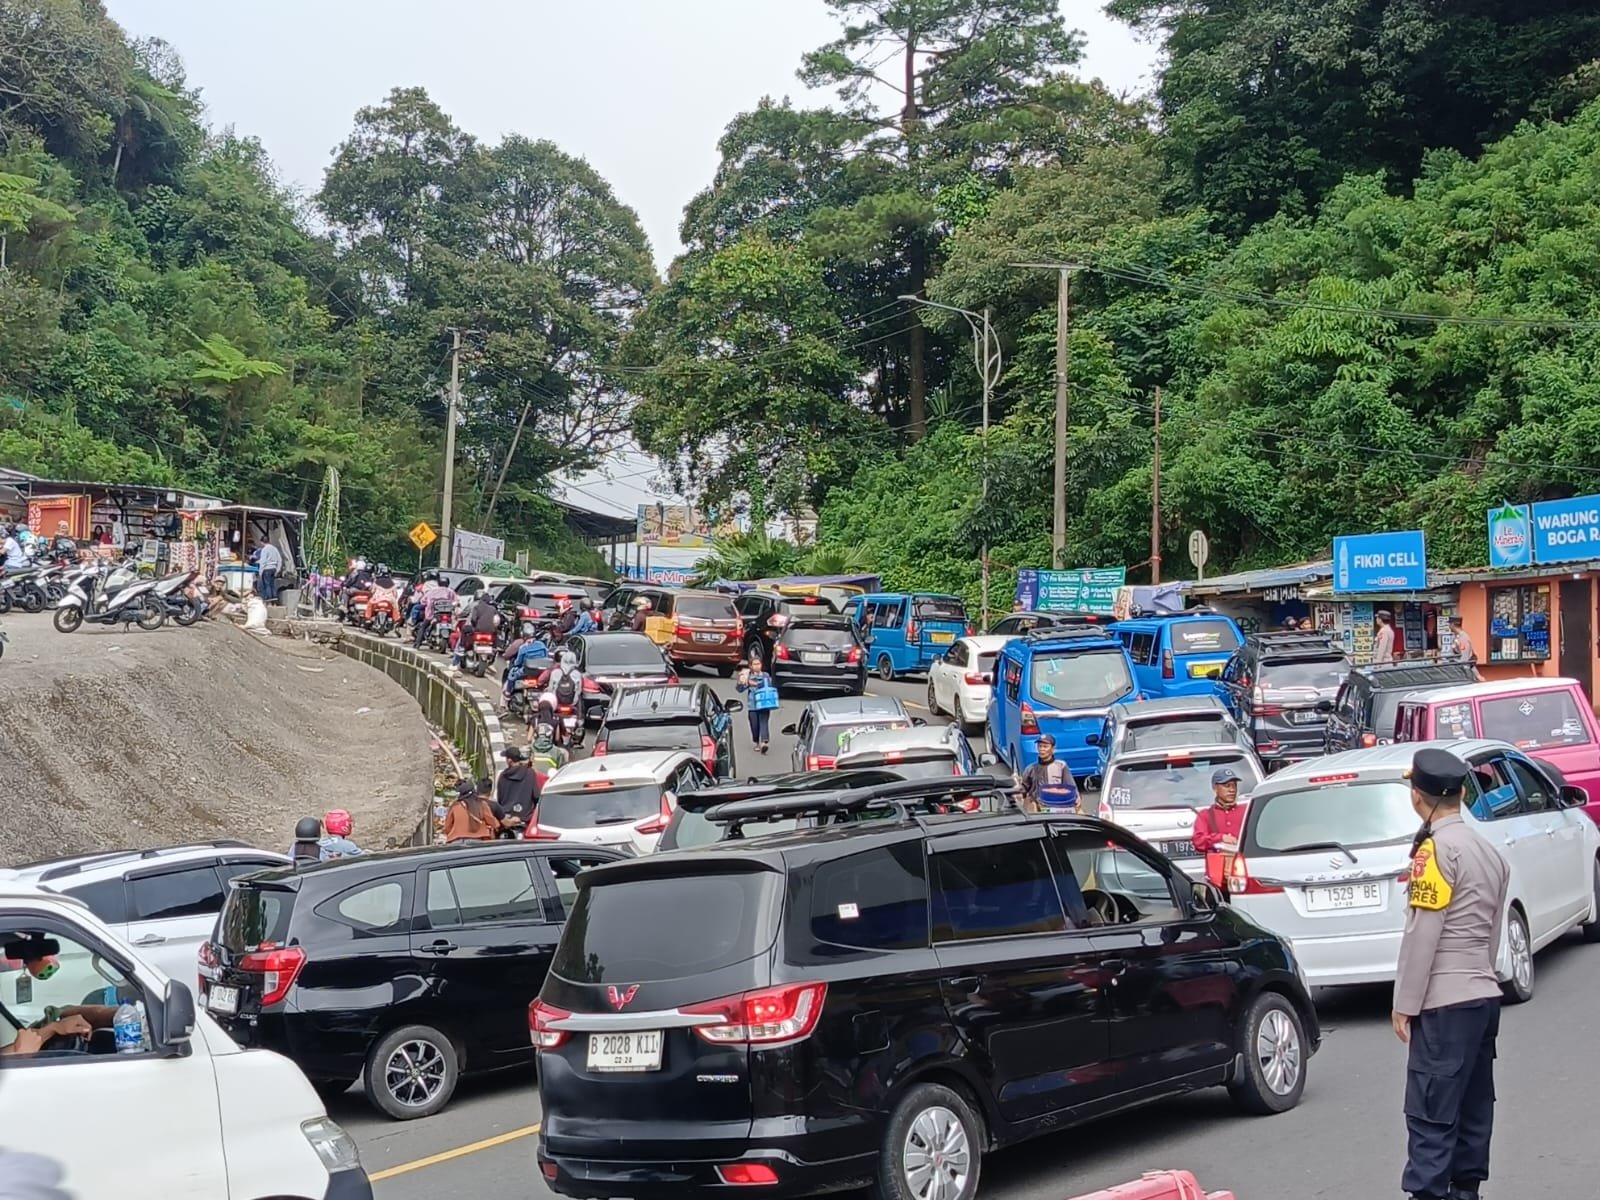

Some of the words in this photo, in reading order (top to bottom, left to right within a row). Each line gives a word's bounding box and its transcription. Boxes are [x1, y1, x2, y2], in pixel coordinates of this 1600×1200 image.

[1537, 509, 1598, 530] WARUNG
[1503, 526, 1513, 536] Le
[1548, 529, 1586, 546] BOGA
[1353, 553, 1385, 568] FIKRI
[1387, 551, 1419, 567] CELL
[1162, 843, 1169, 853] B
[1308, 890, 1315, 904] T
[1327, 887, 1354, 901] 1529
[1363, 884, 1378, 899] BE
[590, 1036, 598, 1055] B
[603, 1035, 631, 1055] 2028
[636, 1034, 656, 1054] KII
